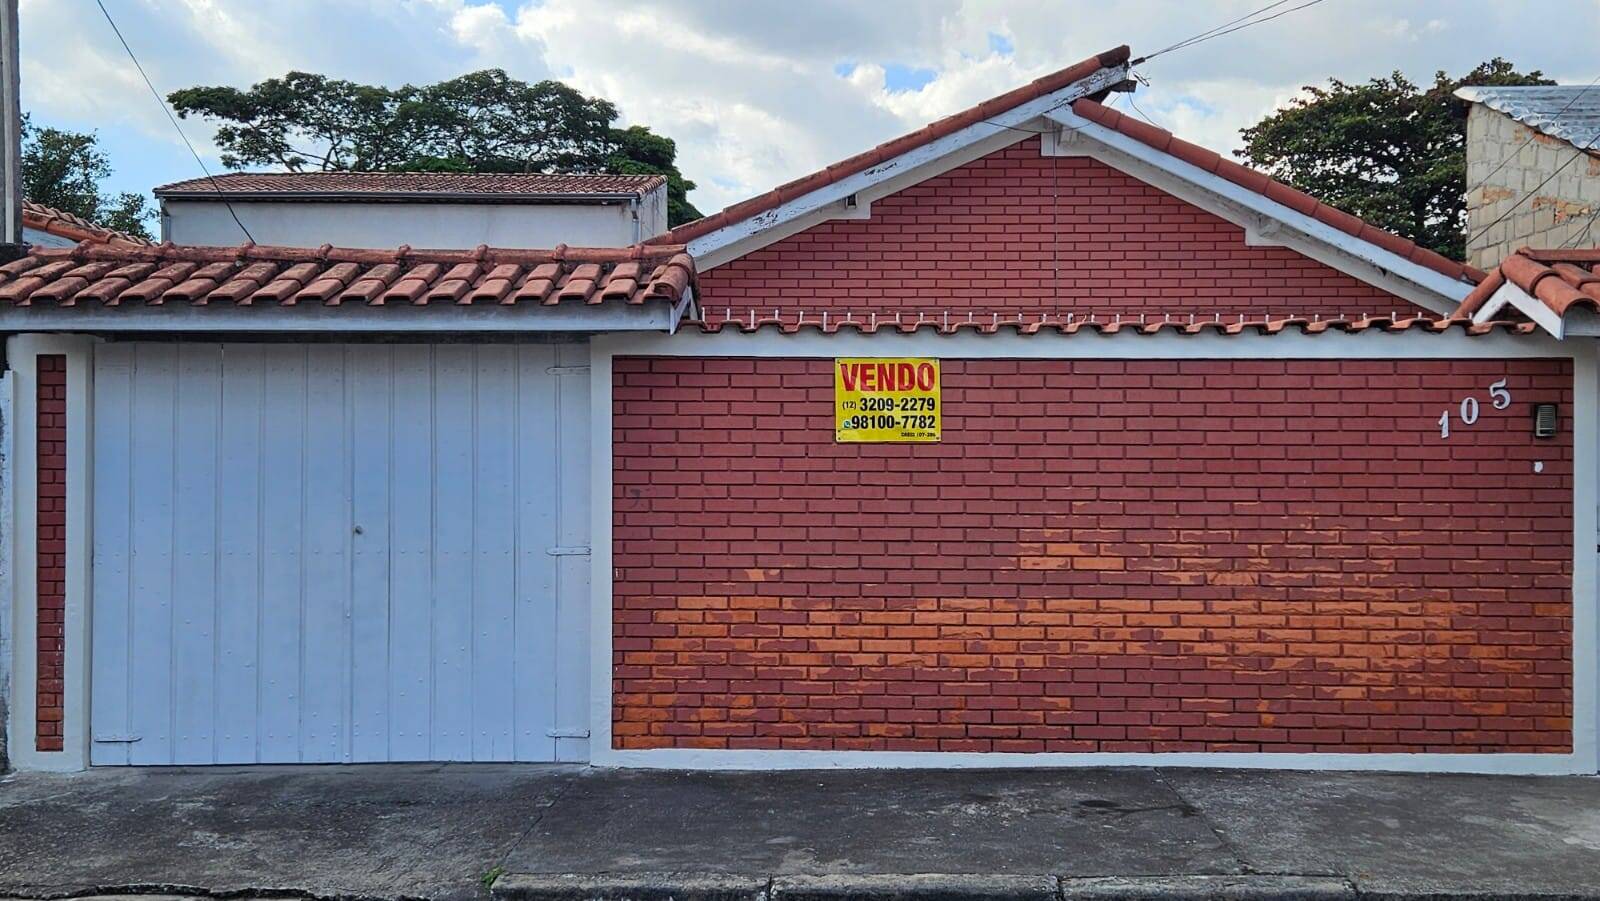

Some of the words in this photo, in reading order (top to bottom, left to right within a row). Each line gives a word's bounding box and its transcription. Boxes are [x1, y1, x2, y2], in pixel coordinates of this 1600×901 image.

[840, 363, 935, 391] VENDO
[842, 401, 857, 410] (12)
[860, 398, 935, 411] 3209-2279
[1438, 378, 1511, 438] 105
[851, 415, 935, 429] 98100-7782
